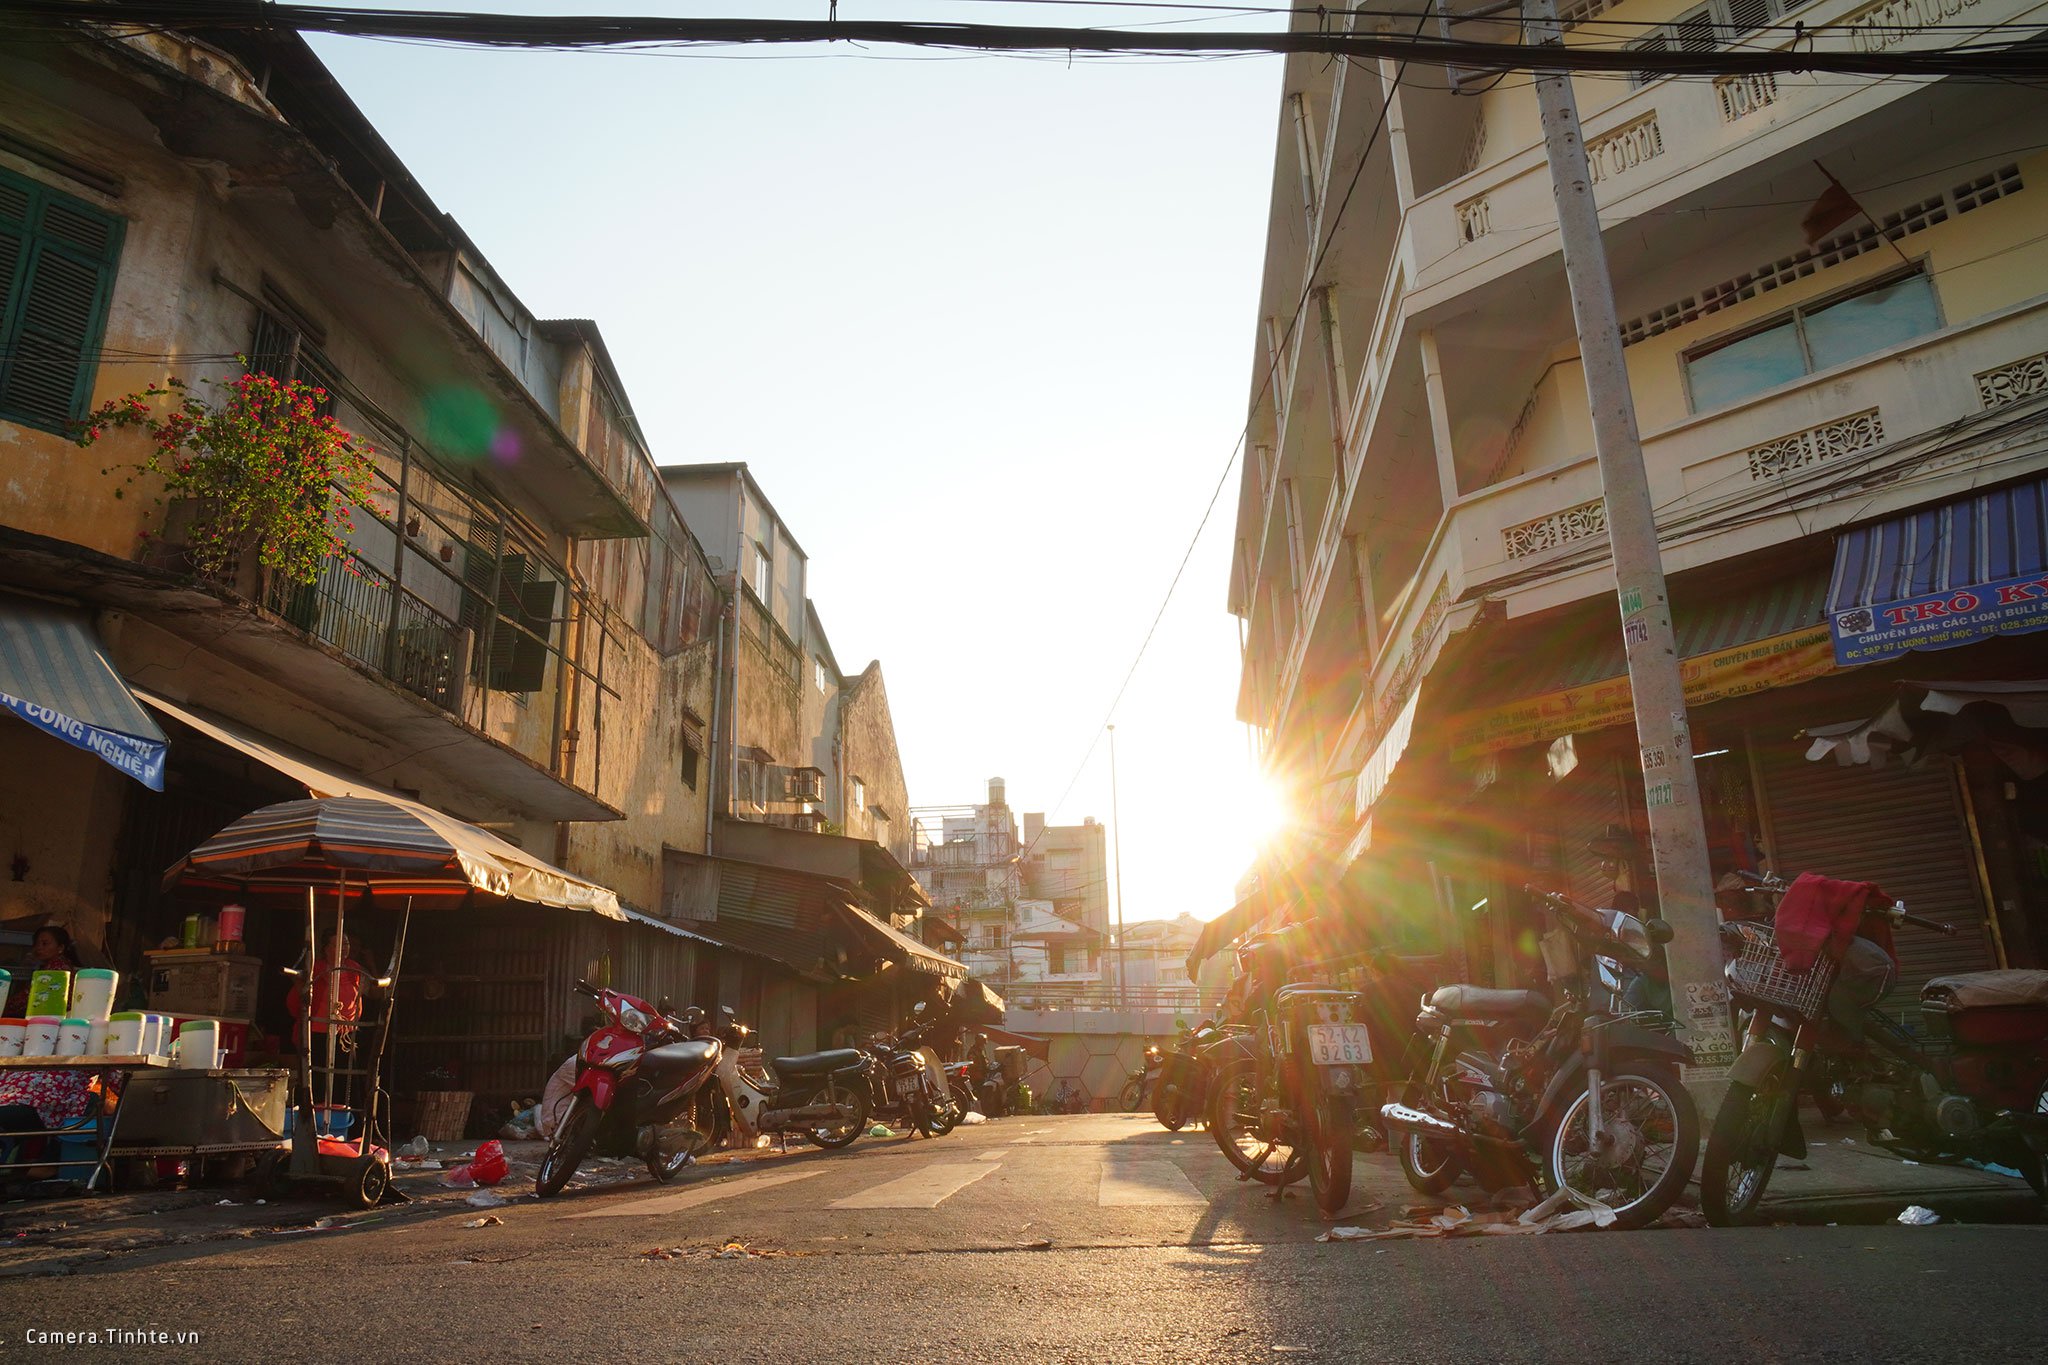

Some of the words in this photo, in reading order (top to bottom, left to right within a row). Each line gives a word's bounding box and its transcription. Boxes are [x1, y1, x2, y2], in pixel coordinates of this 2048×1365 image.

[1883, 591, 1979, 625] TRÒ
[1859, 629, 1906, 644] CHUYÊN
[1942, 616, 1968, 629] CÁC
[1971, 611, 2001, 623] LOẠI
[2005, 604, 2037, 617] BULI
[1713, 650, 1749, 668] CHUYÊN
[1751, 645, 1771, 659] MUA
[1773, 639, 1793, 654] BÁN
[1883, 642, 1894, 651] 97
[87, 730, 156, 778] NGHIỆP
[1321, 1045, 1363, 1061] 9263
